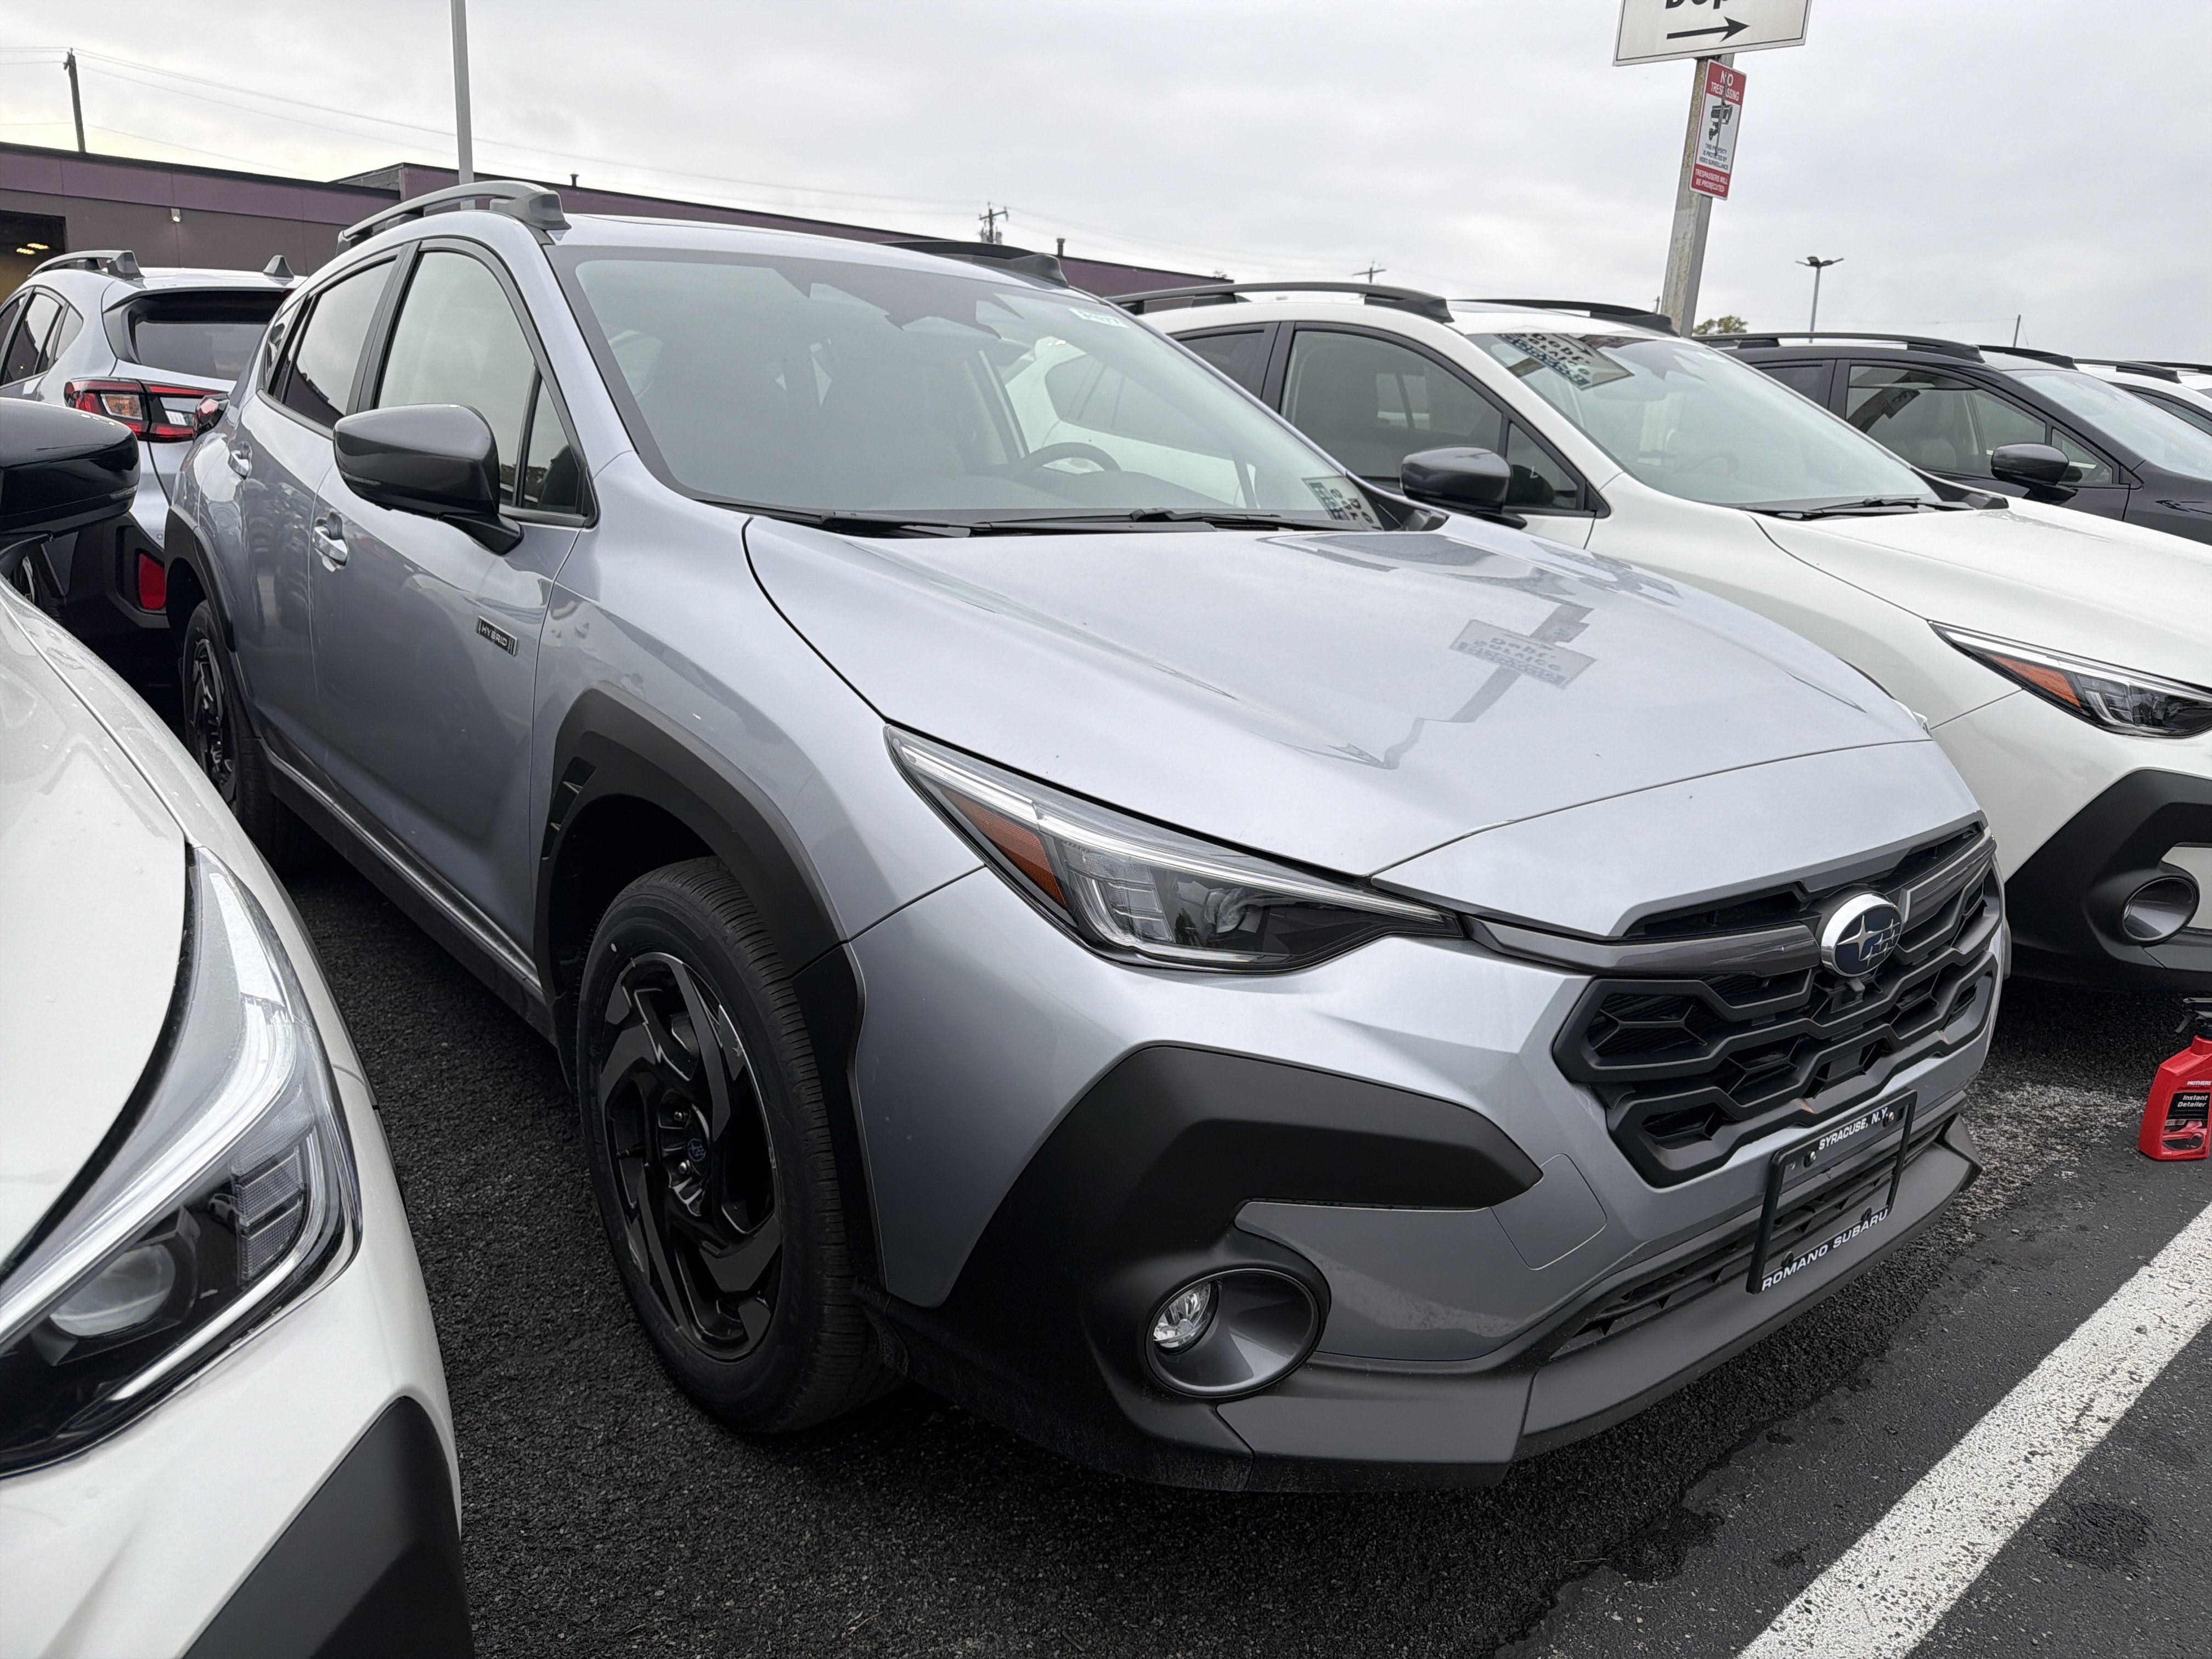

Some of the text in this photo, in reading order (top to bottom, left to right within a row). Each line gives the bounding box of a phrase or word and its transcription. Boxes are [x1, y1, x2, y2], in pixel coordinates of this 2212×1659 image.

[1720, 70, 1734, 87] NO
[1711, 81, 1740, 101] TRESSSING
[482, 624, 507, 646] HYBRID
[1819, 1107, 1888, 1150] SYRACUSE, N.Y.
[1761, 1209, 1888, 1291] ROMANO SUBARU
